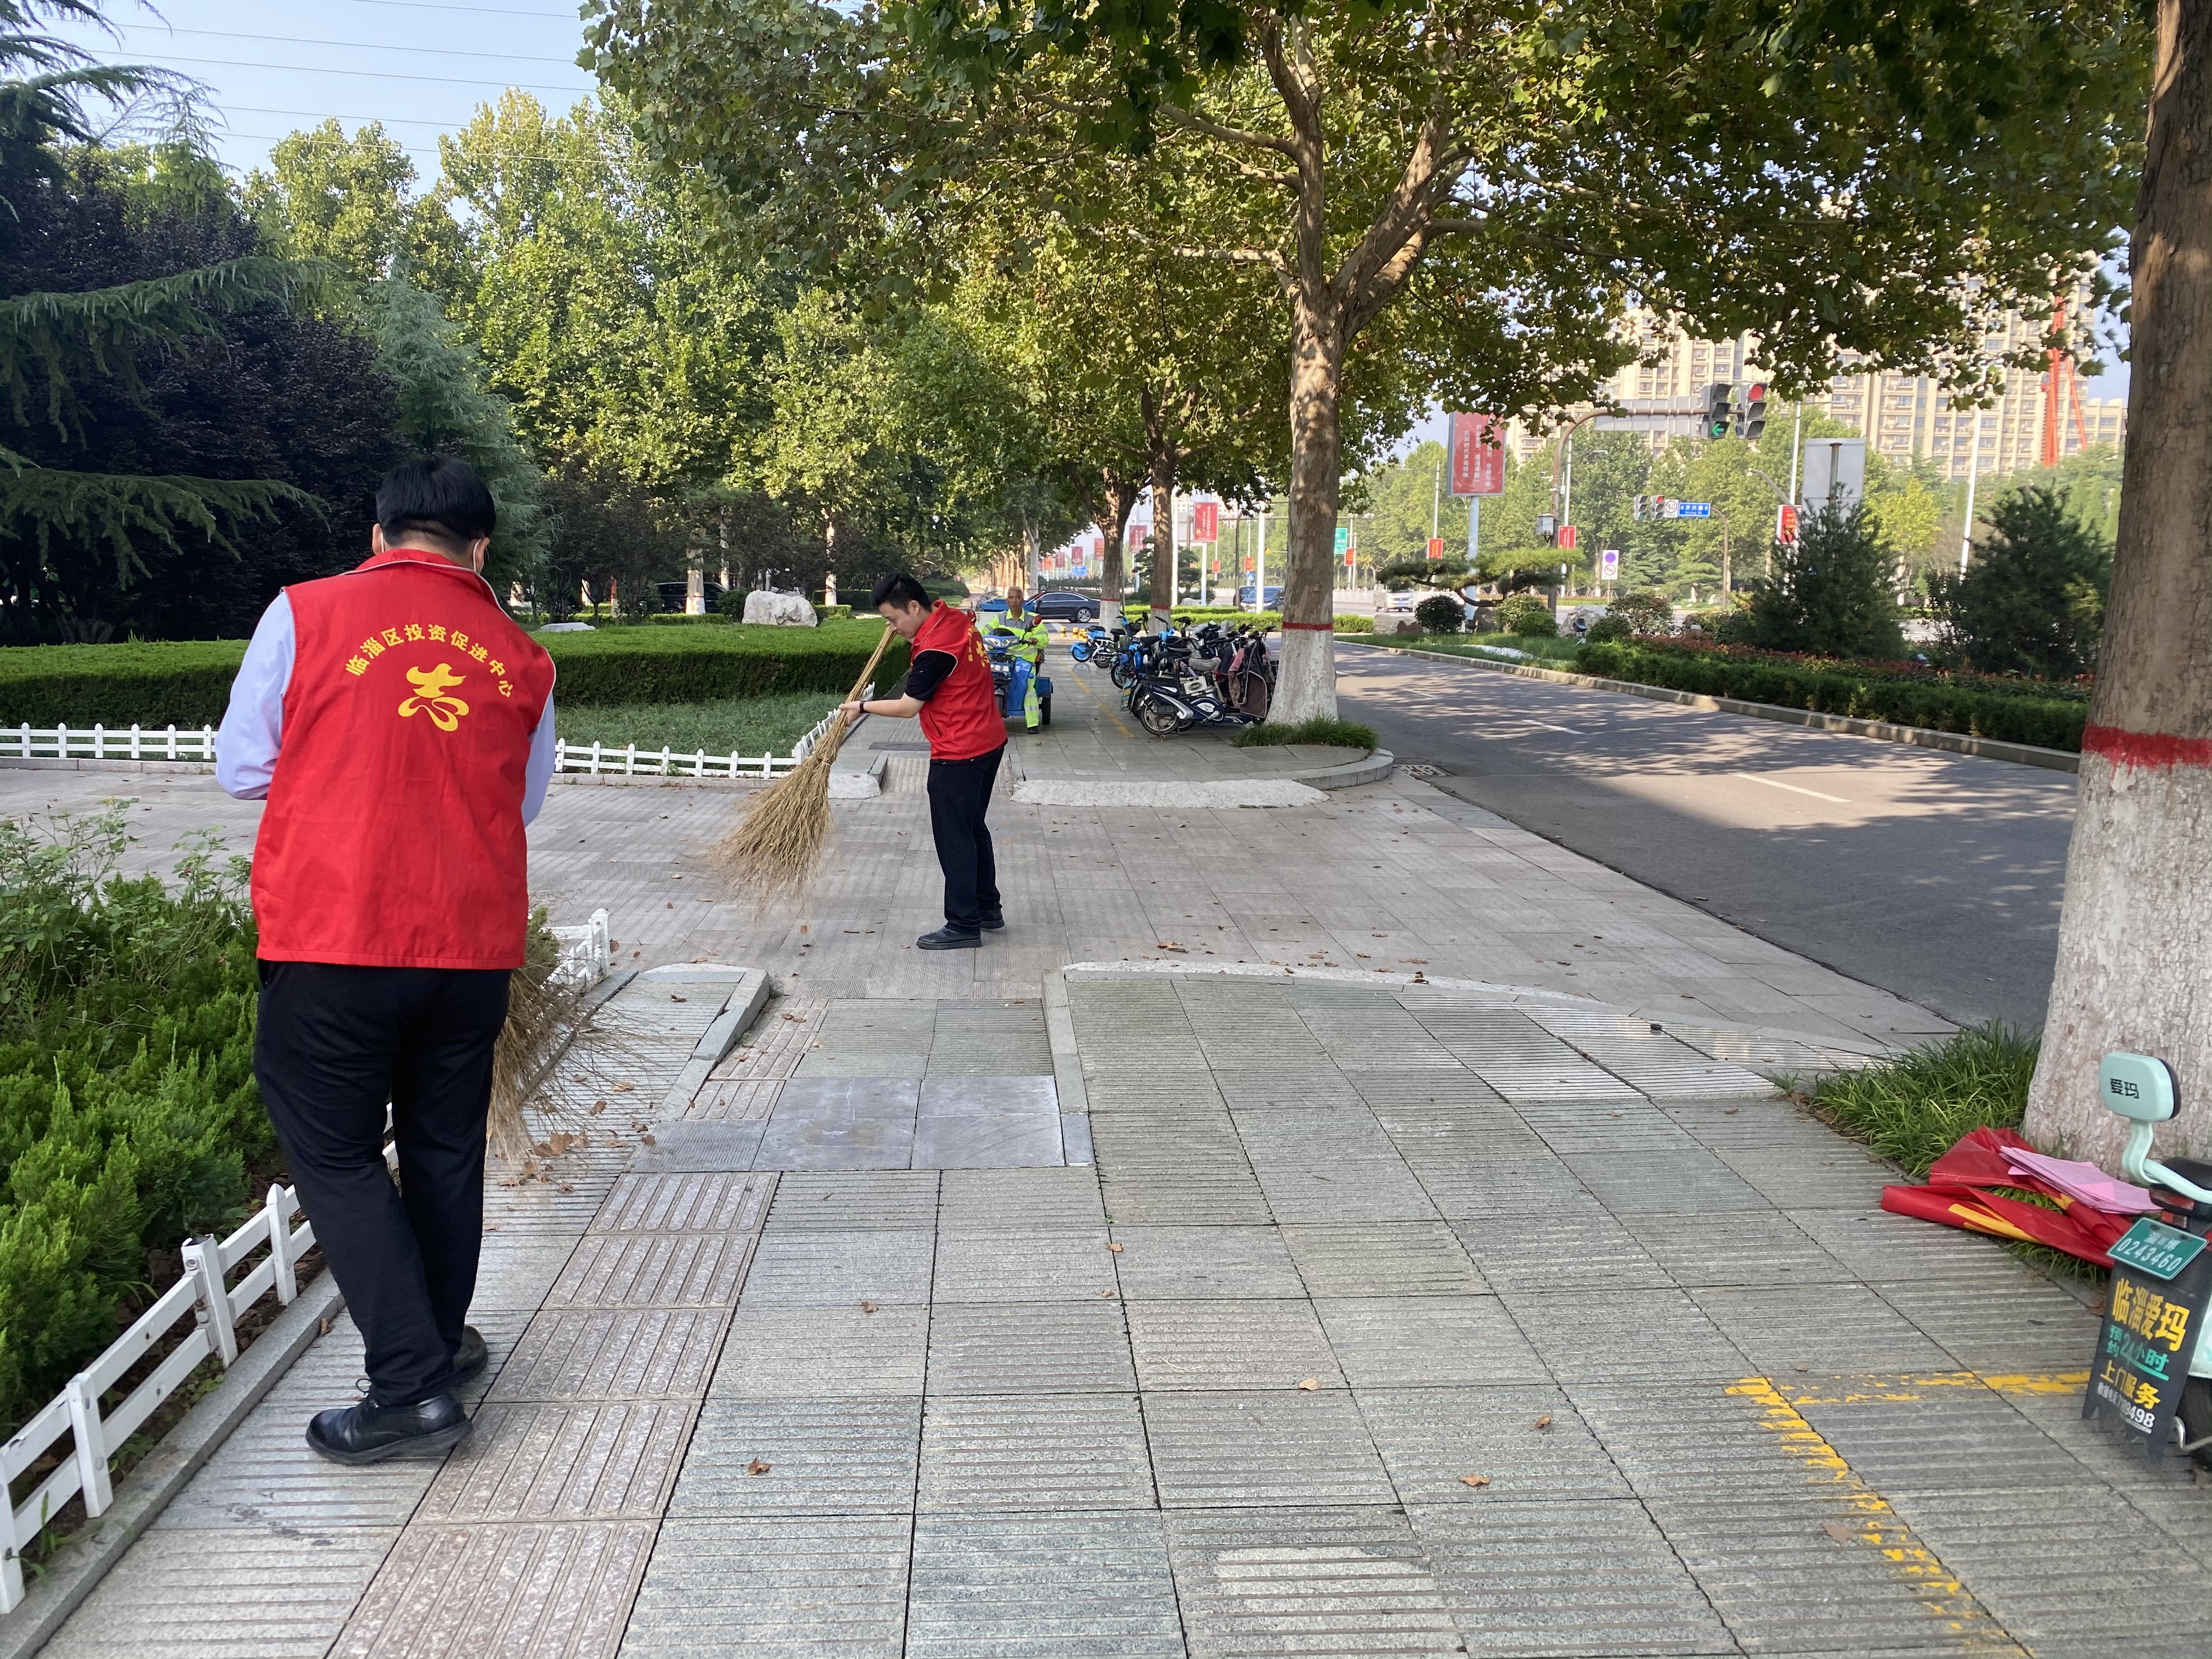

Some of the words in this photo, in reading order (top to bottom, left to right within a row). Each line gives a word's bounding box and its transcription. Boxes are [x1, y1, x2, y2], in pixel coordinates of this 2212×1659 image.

[346, 624, 513, 698] 临淄区投资促进中心
[2111, 1077, 2140, 1099] 爱玛
[2117, 1238, 2183, 1271] 0243460
[2112, 1278, 2190, 1351] 临淄爱玛
[2100, 1359, 2163, 1409] 上门服务
